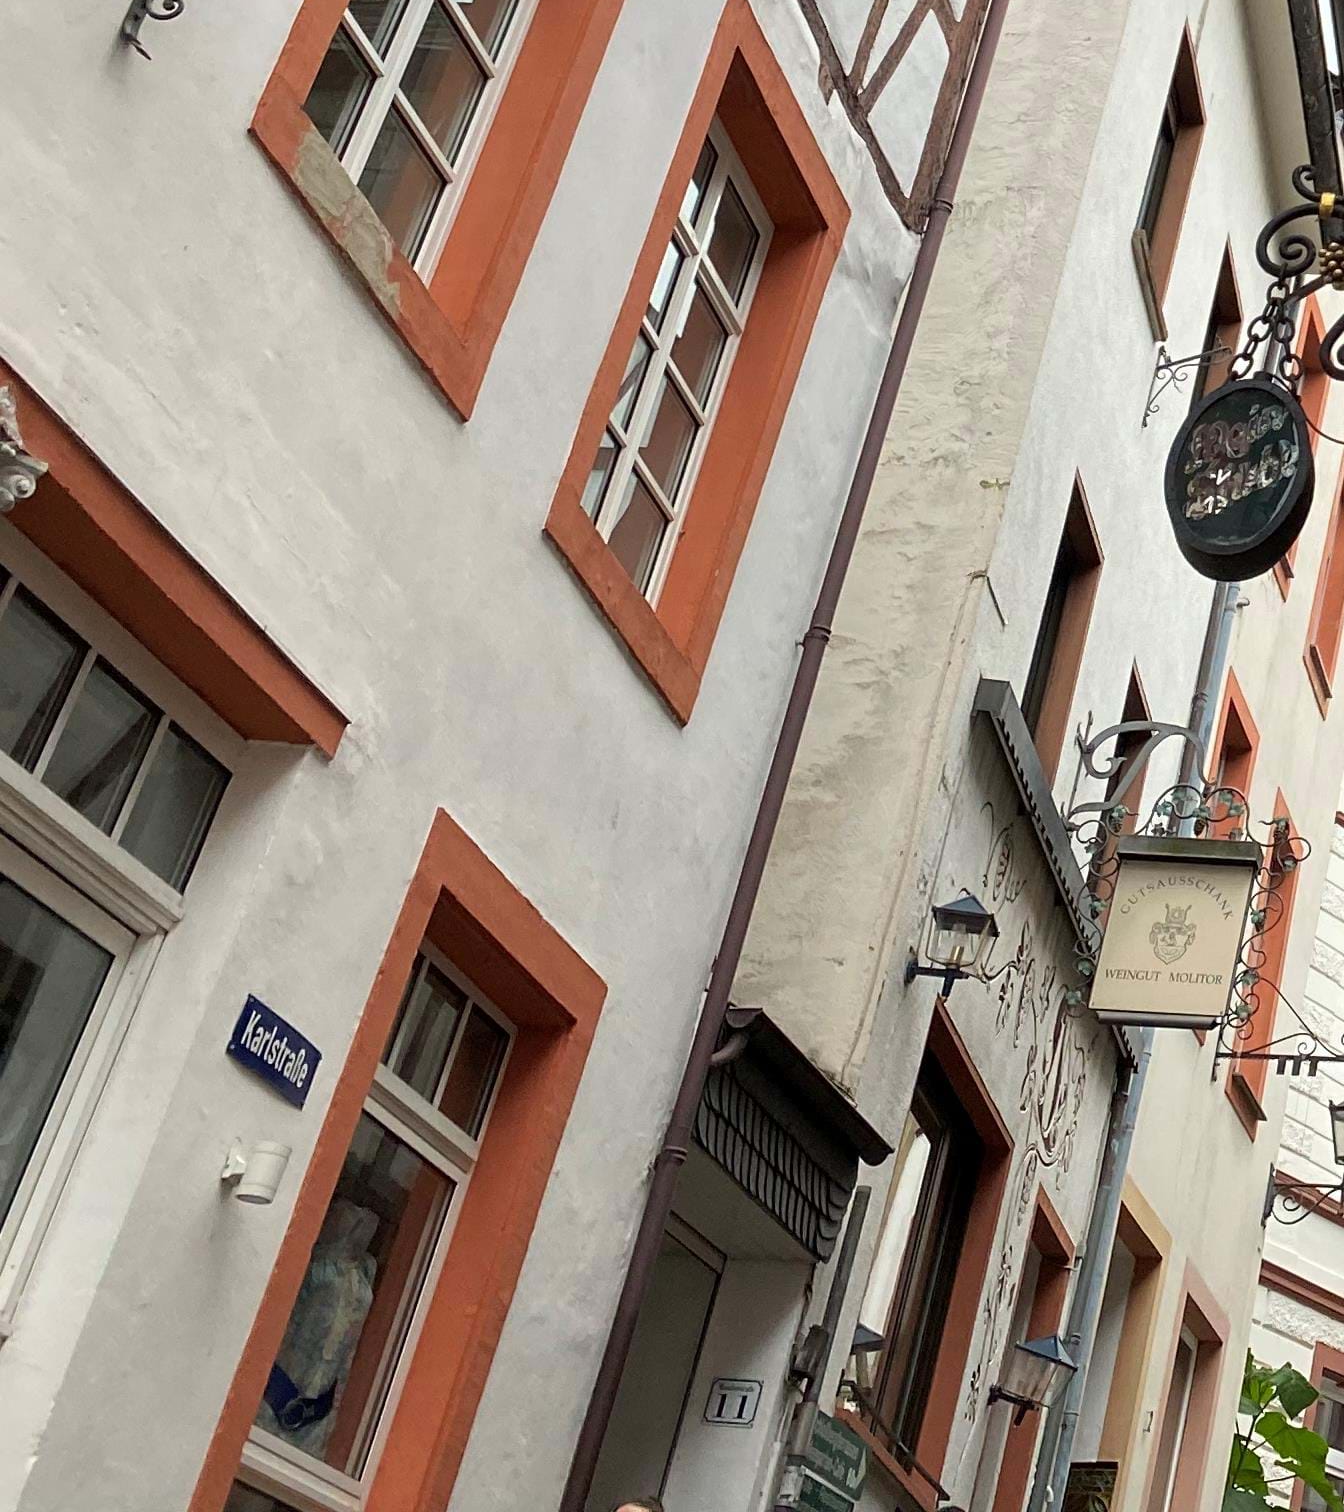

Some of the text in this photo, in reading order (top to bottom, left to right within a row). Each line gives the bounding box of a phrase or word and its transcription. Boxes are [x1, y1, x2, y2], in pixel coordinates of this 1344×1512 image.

[1120, 875, 1235, 921] GUTSAUSSCHANK
[1105, 968, 1223, 984] WEINGUT MOLITOR
[240, 1010, 309, 1088] Karlstraße
[712, 1393, 748, 1419] 11
